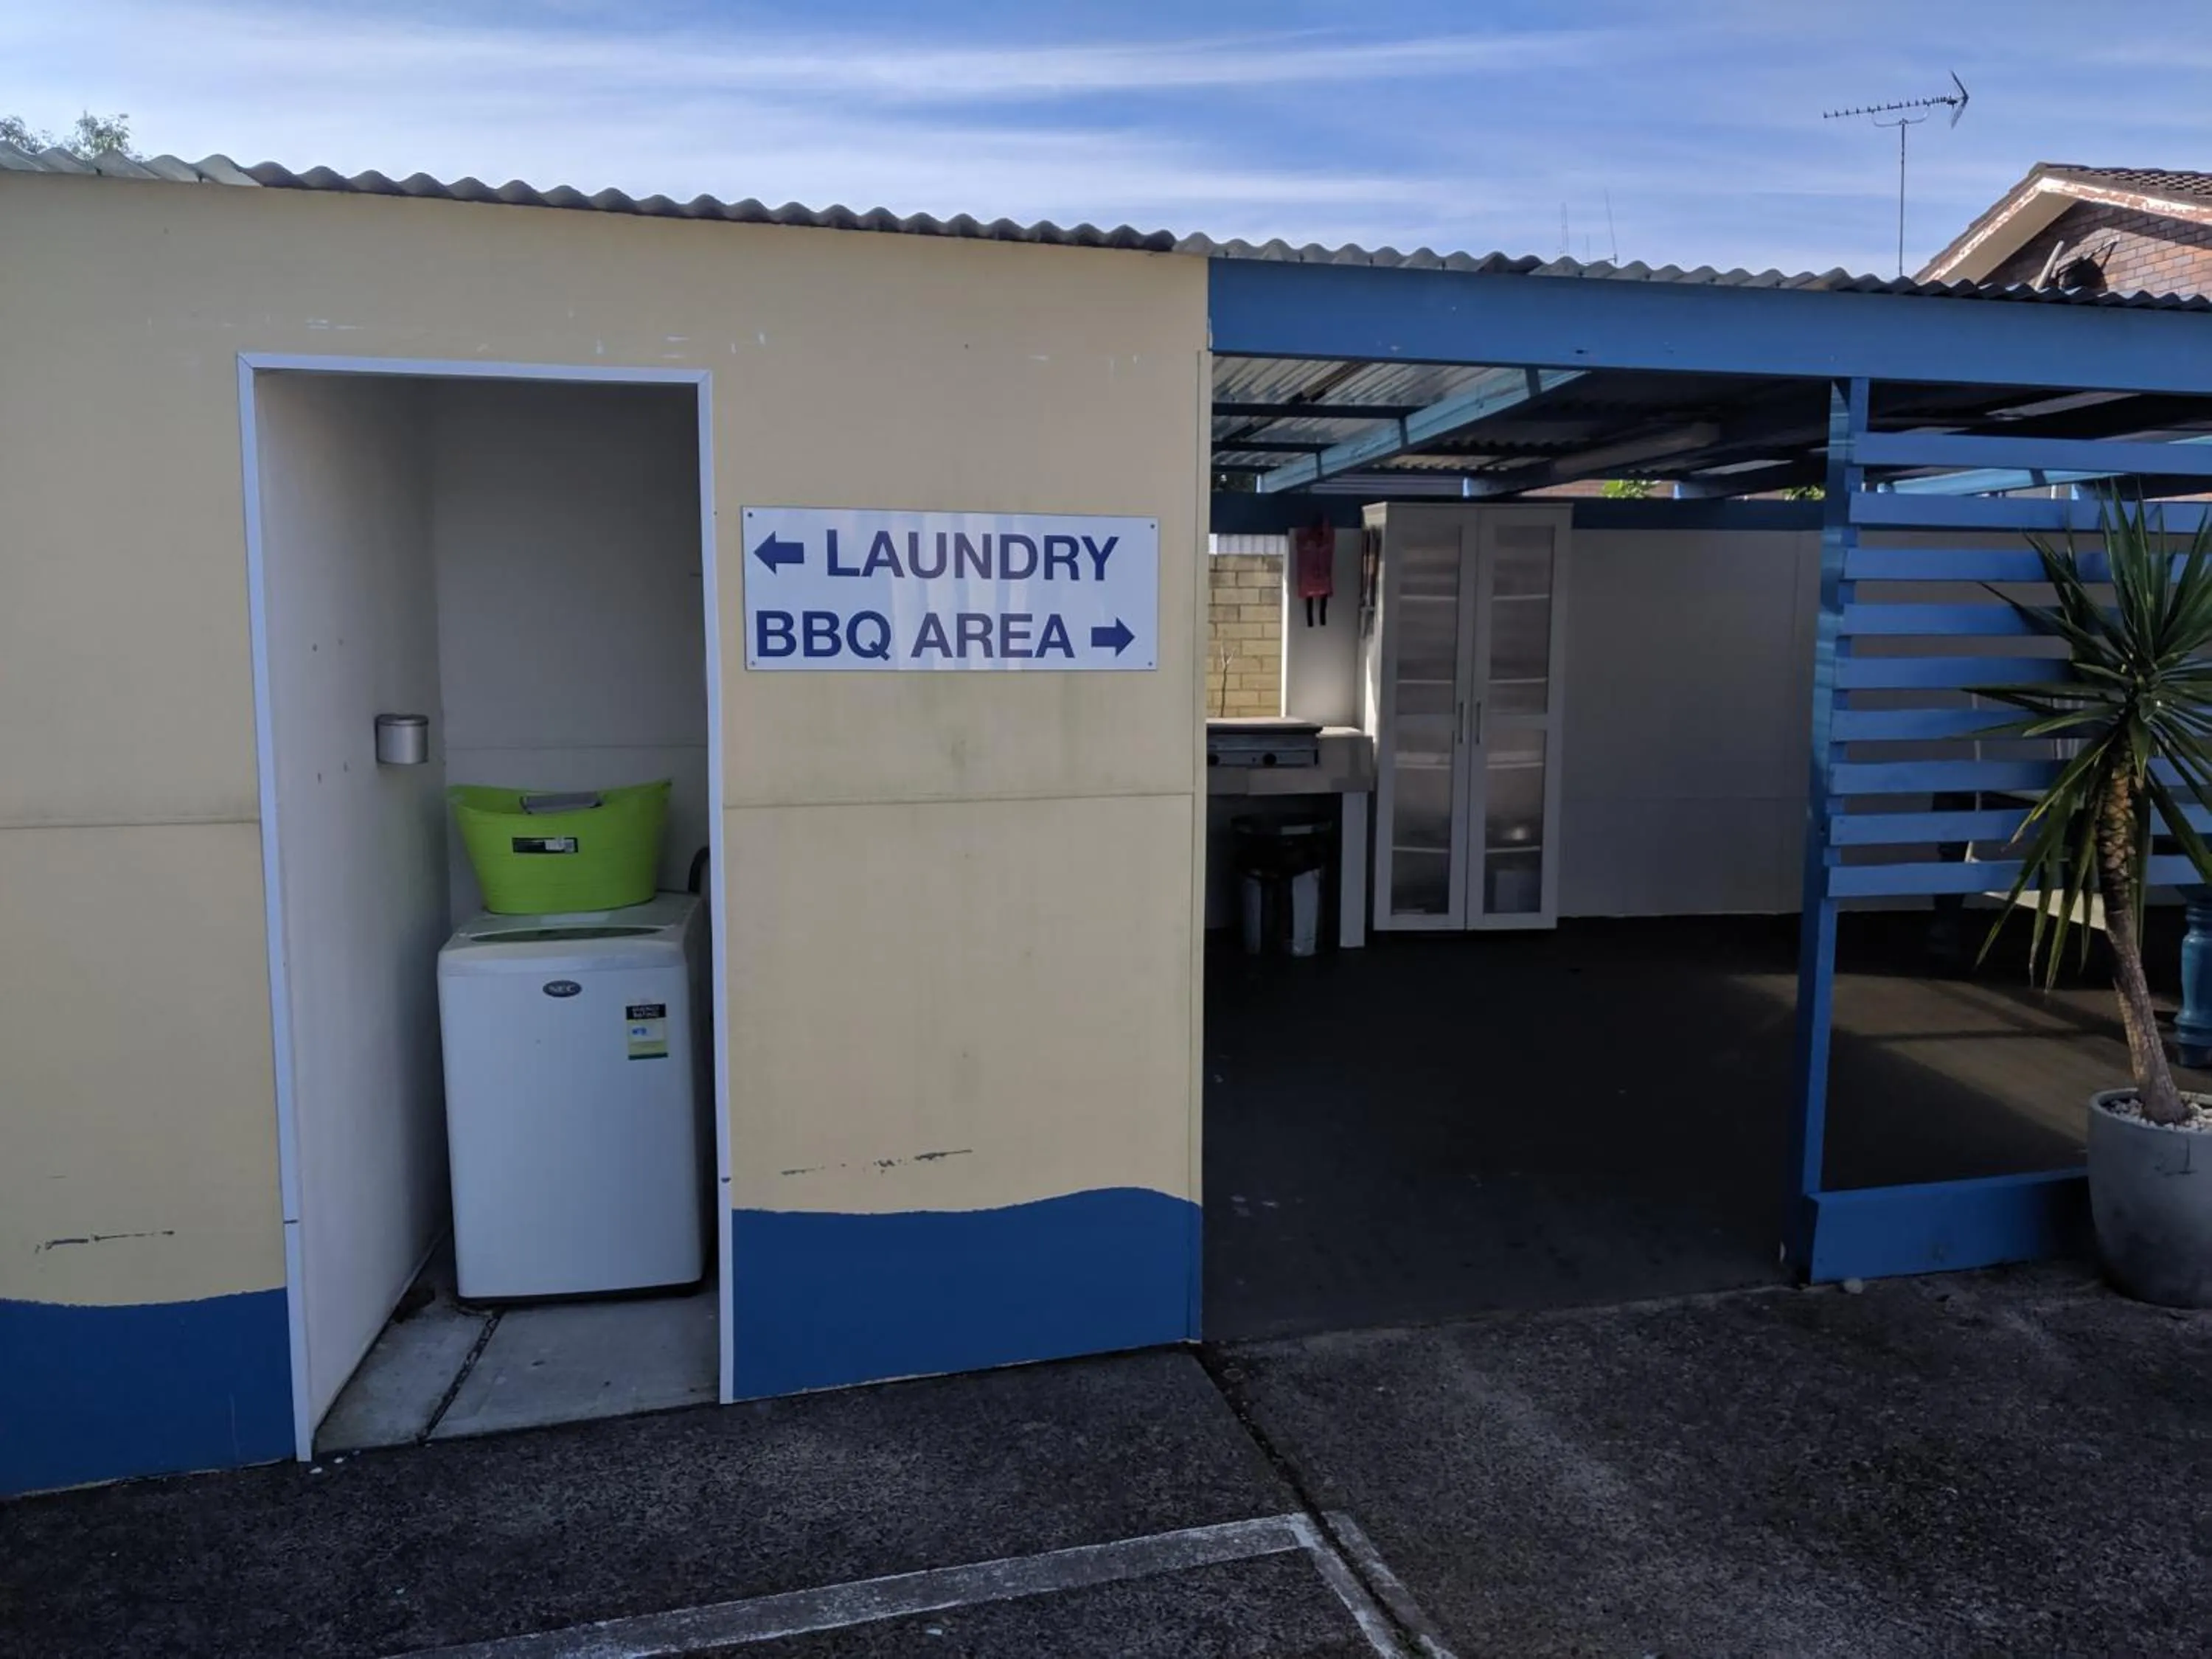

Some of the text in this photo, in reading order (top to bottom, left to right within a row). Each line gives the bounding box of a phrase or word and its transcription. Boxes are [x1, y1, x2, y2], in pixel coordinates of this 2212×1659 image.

[827, 529, 1119, 581] LAUNDRY
[757, 611, 1075, 661] BBQ AREA
